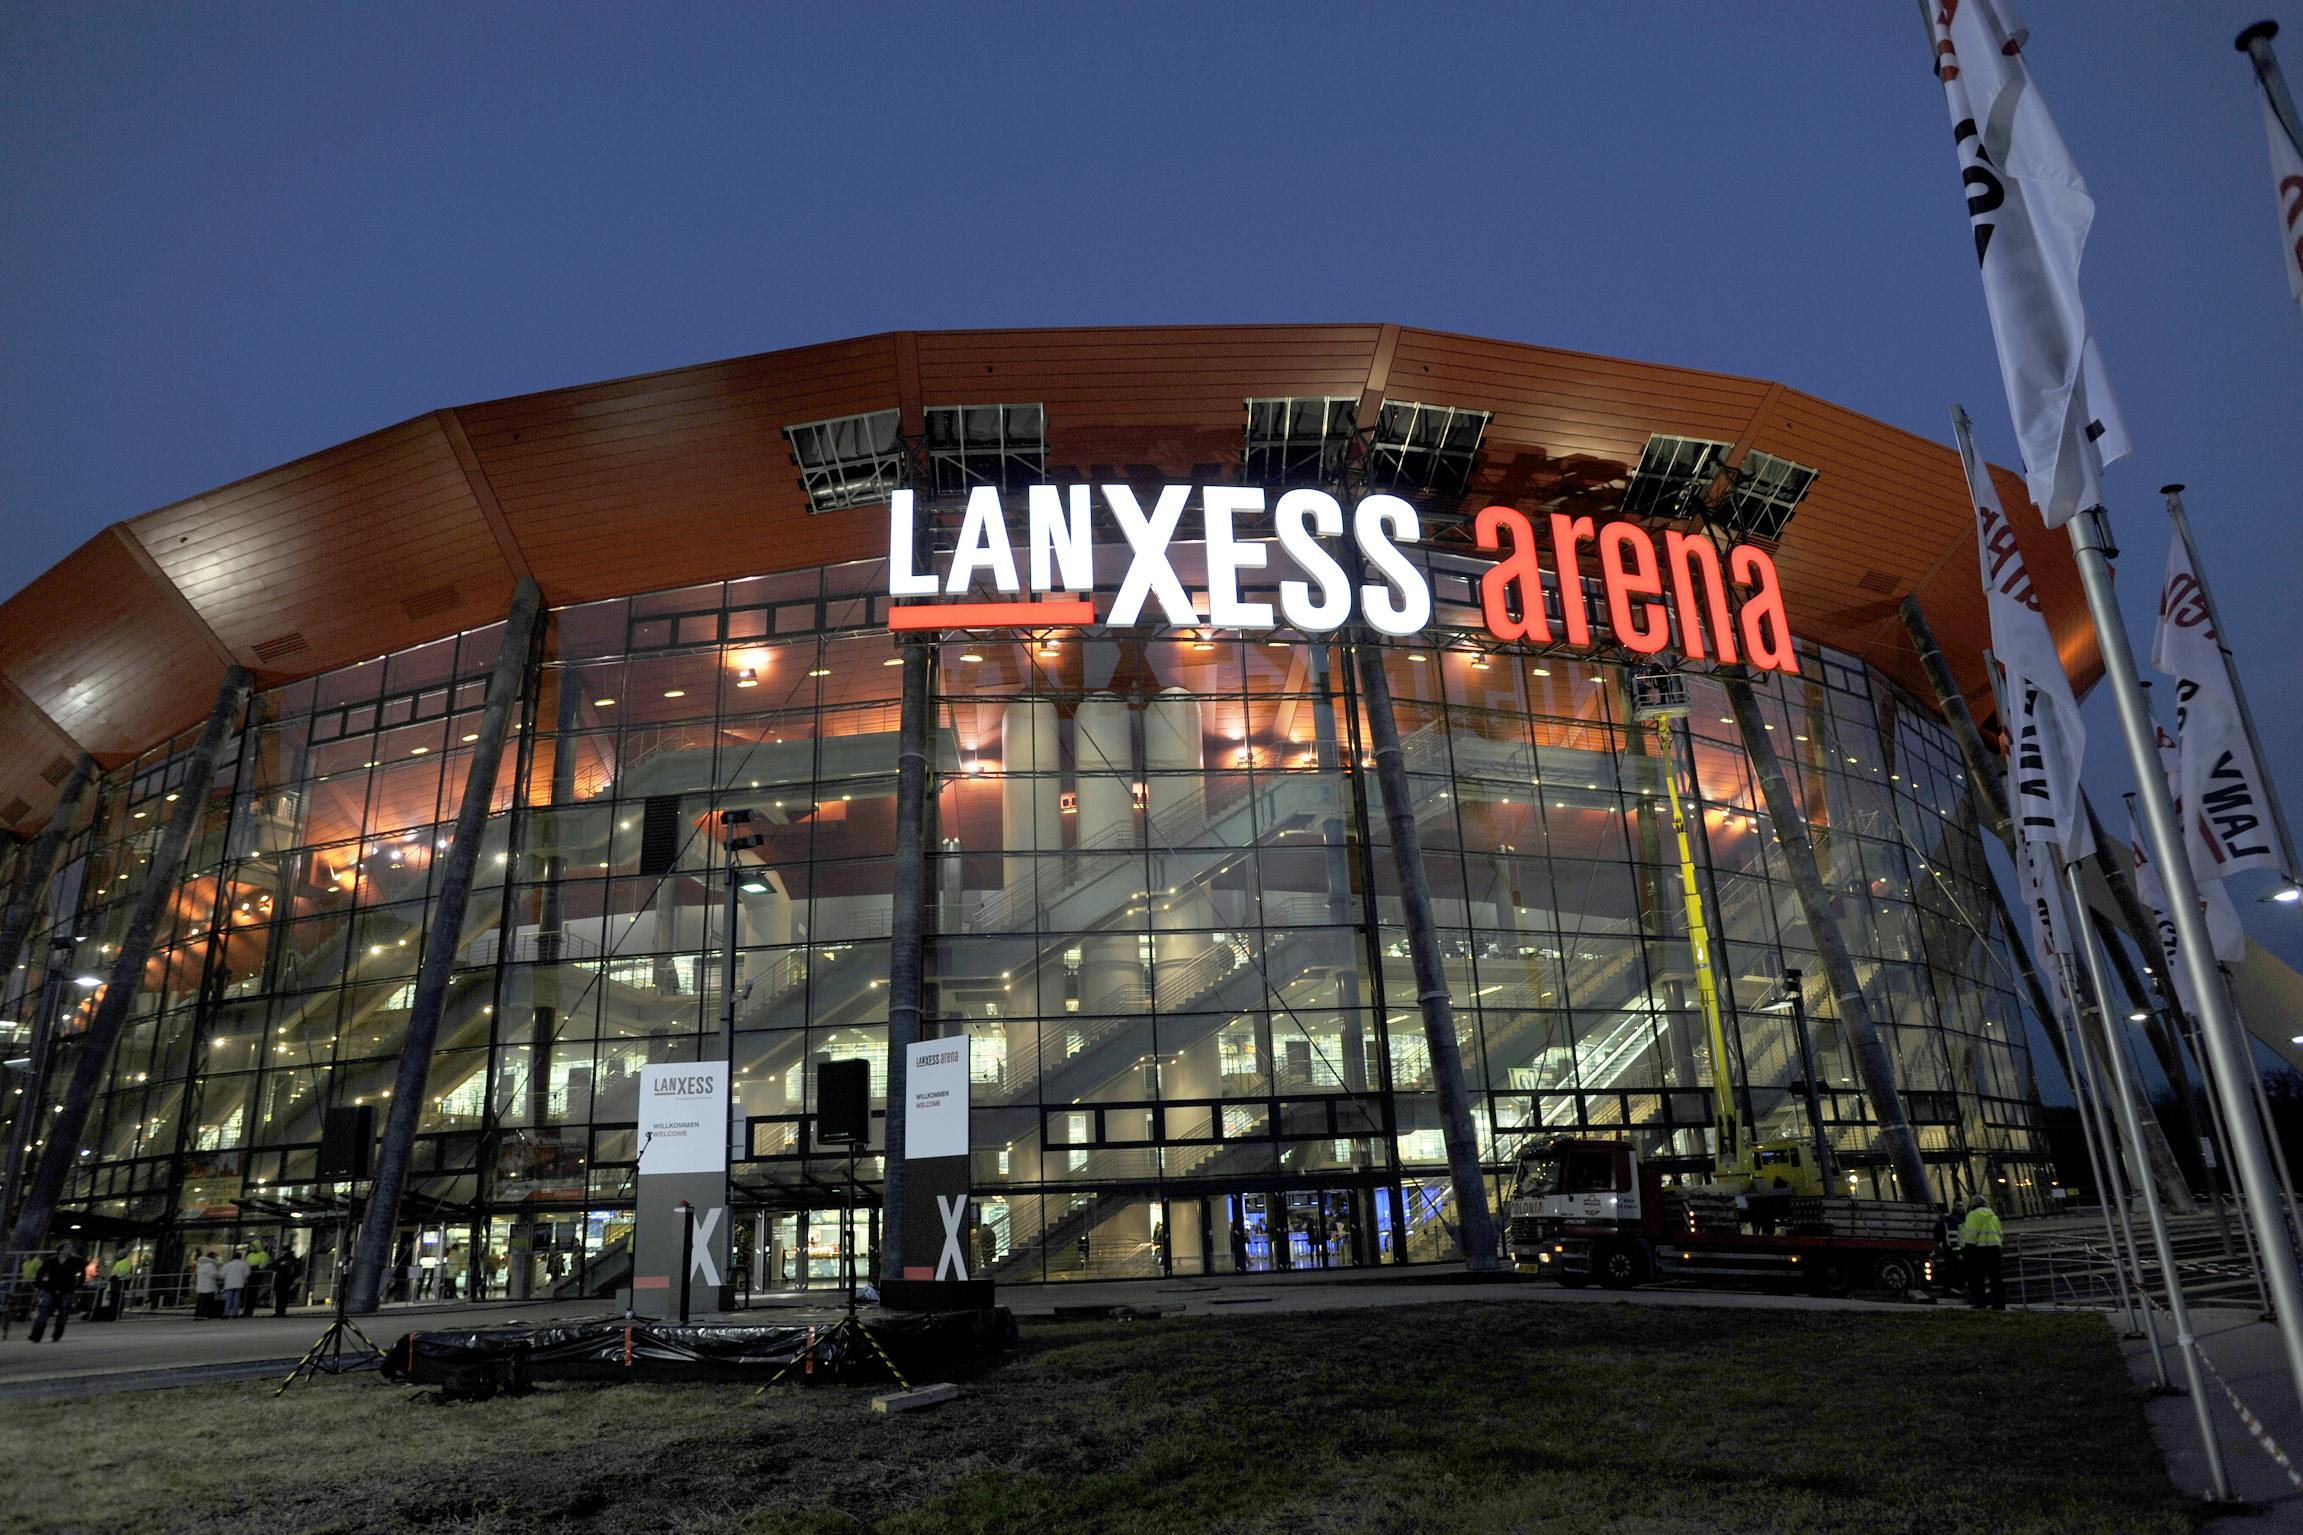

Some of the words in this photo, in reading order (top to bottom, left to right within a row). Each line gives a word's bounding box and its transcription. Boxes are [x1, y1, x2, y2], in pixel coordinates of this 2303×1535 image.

[889, 484, 1432, 637] LANXESS
[1475, 506, 1800, 676] arena
[916, 1054, 940, 1067] LANXESS
[940, 1051, 959, 1065] arena
[654, 1076, 714, 1096] LANXESS
[916, 1090, 950, 1100] WILLKOMMEN
[916, 1100, 941, 1109] WELCOME
[653, 1121, 700, 1129] WILLKOMMEN
[934, 1194, 968, 1282] X
